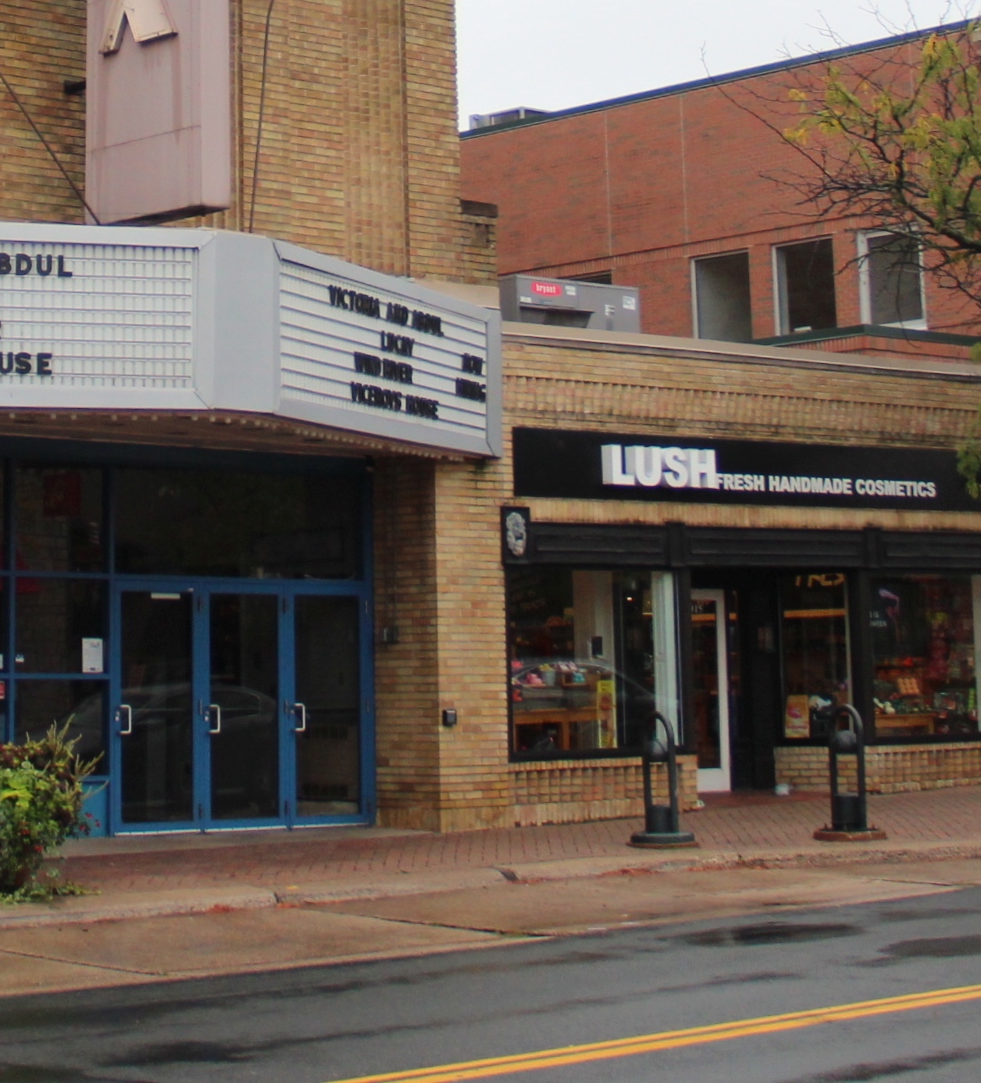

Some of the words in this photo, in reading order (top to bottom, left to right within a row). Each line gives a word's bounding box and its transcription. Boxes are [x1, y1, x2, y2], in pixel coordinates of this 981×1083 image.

[327, 285, 381, 319] VICTORIA
[386, 302, 409, 326] AND
[535, 283, 557, 295] bryant
[380, 330, 415, 357] LUCKY
[353, 351, 381, 377] WIND
[382, 358, 413, 384] RIVER
[350, 381, 402, 411] VICEROYS
[405, 394, 439, 419] HOUSE
[601, 444, 719, 490] LUSH
[717, 473, 766, 492] FRESH
[769, 475, 853, 495] HANDMADE
[856, 479, 937, 498] COSMETICS
